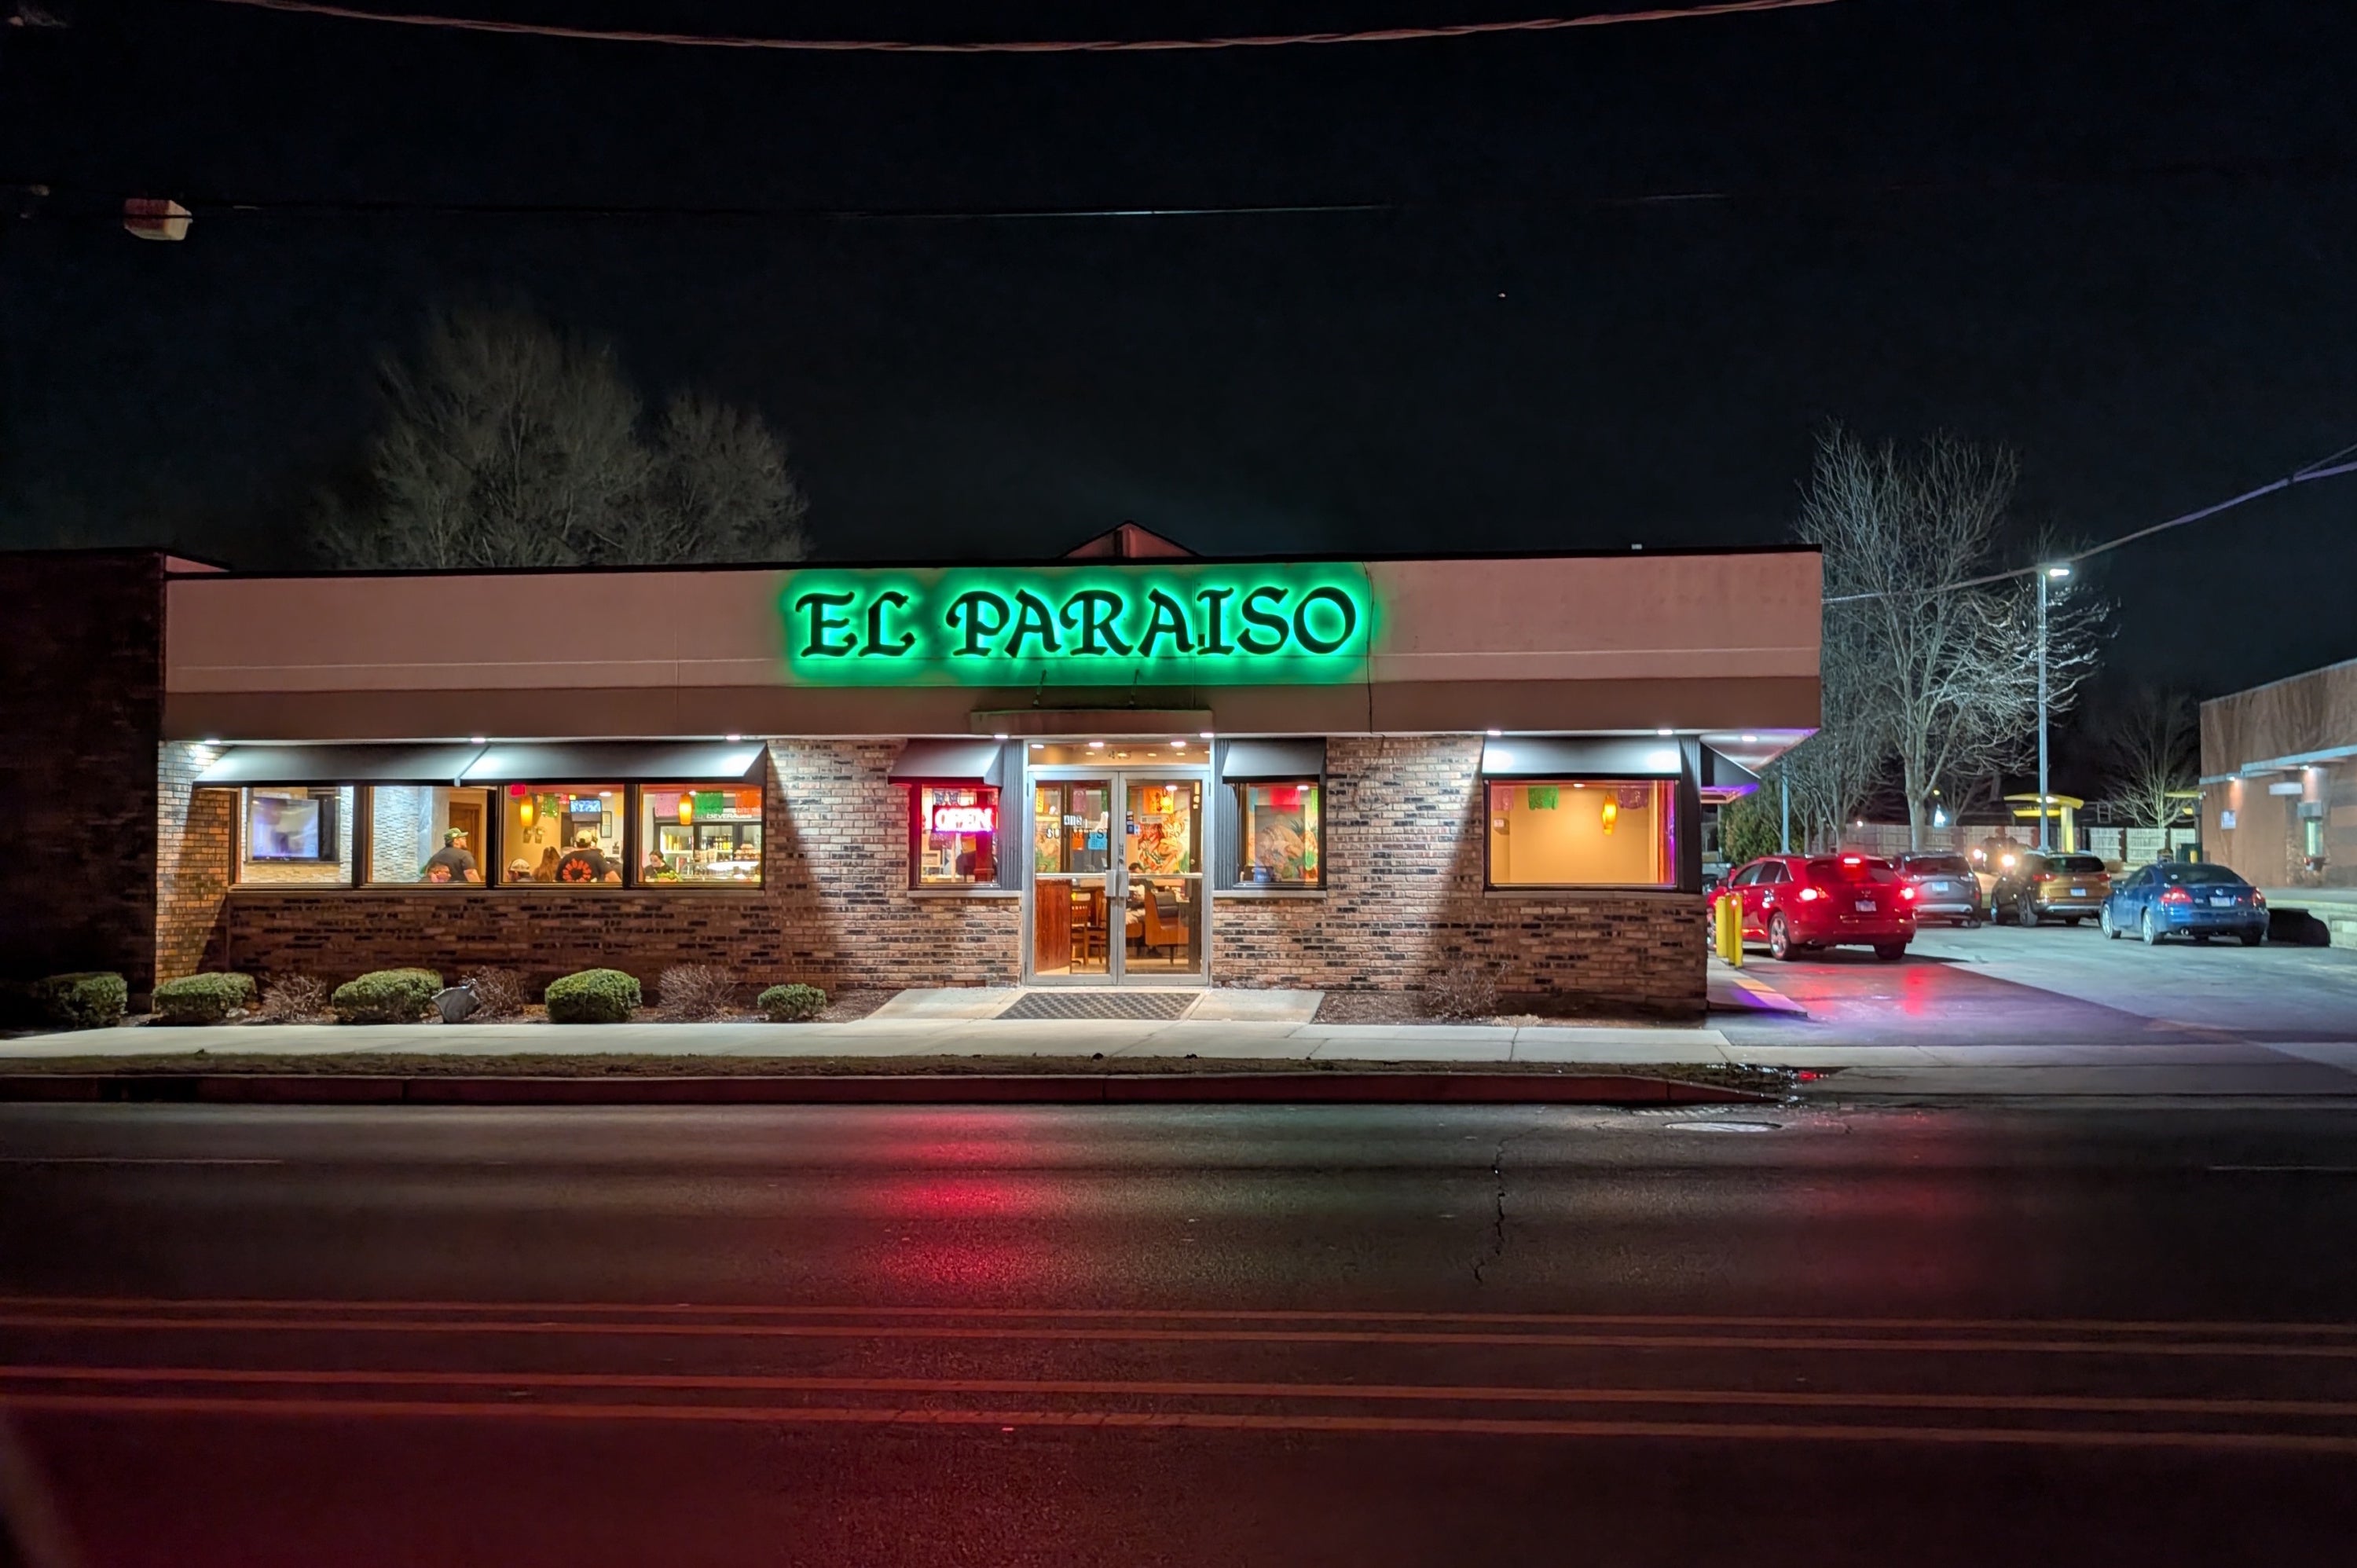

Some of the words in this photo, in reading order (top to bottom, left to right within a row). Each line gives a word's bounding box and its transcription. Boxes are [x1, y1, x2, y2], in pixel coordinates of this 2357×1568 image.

[795, 589, 917, 658] EL
[944, 588, 1357, 658] PARAISO
[934, 808, 993, 831] OPEN
[1047, 828, 1093, 839] SUMIT
